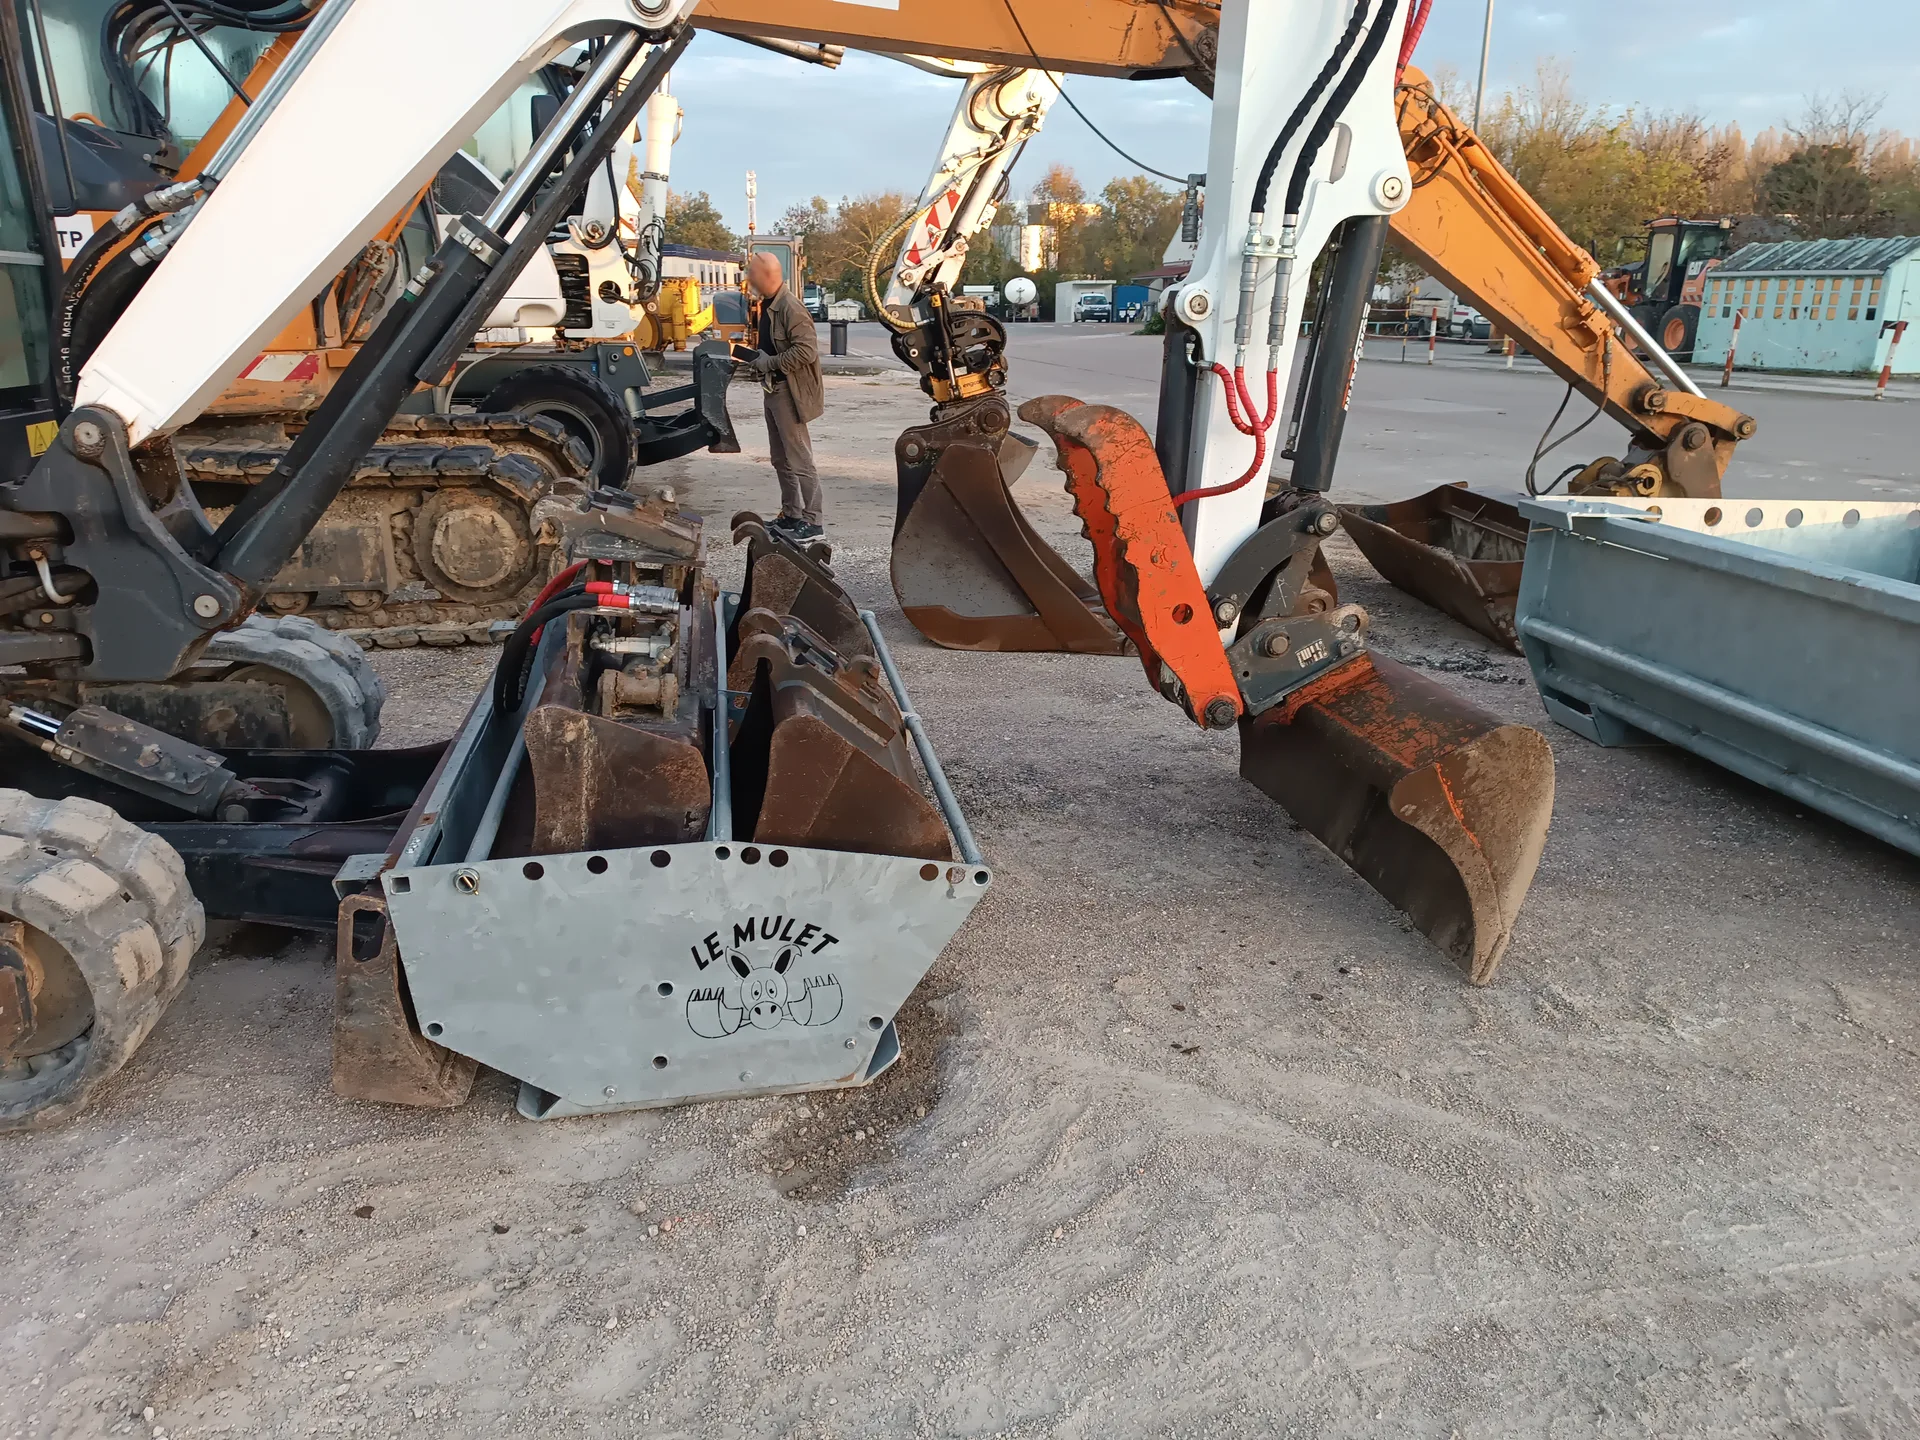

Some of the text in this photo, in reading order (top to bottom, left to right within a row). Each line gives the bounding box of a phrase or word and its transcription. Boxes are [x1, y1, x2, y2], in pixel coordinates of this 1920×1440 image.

[56, 230, 83, 248] TP
[1687, 261, 1704, 276] CAT
[690, 915, 840, 971] LE MULET
